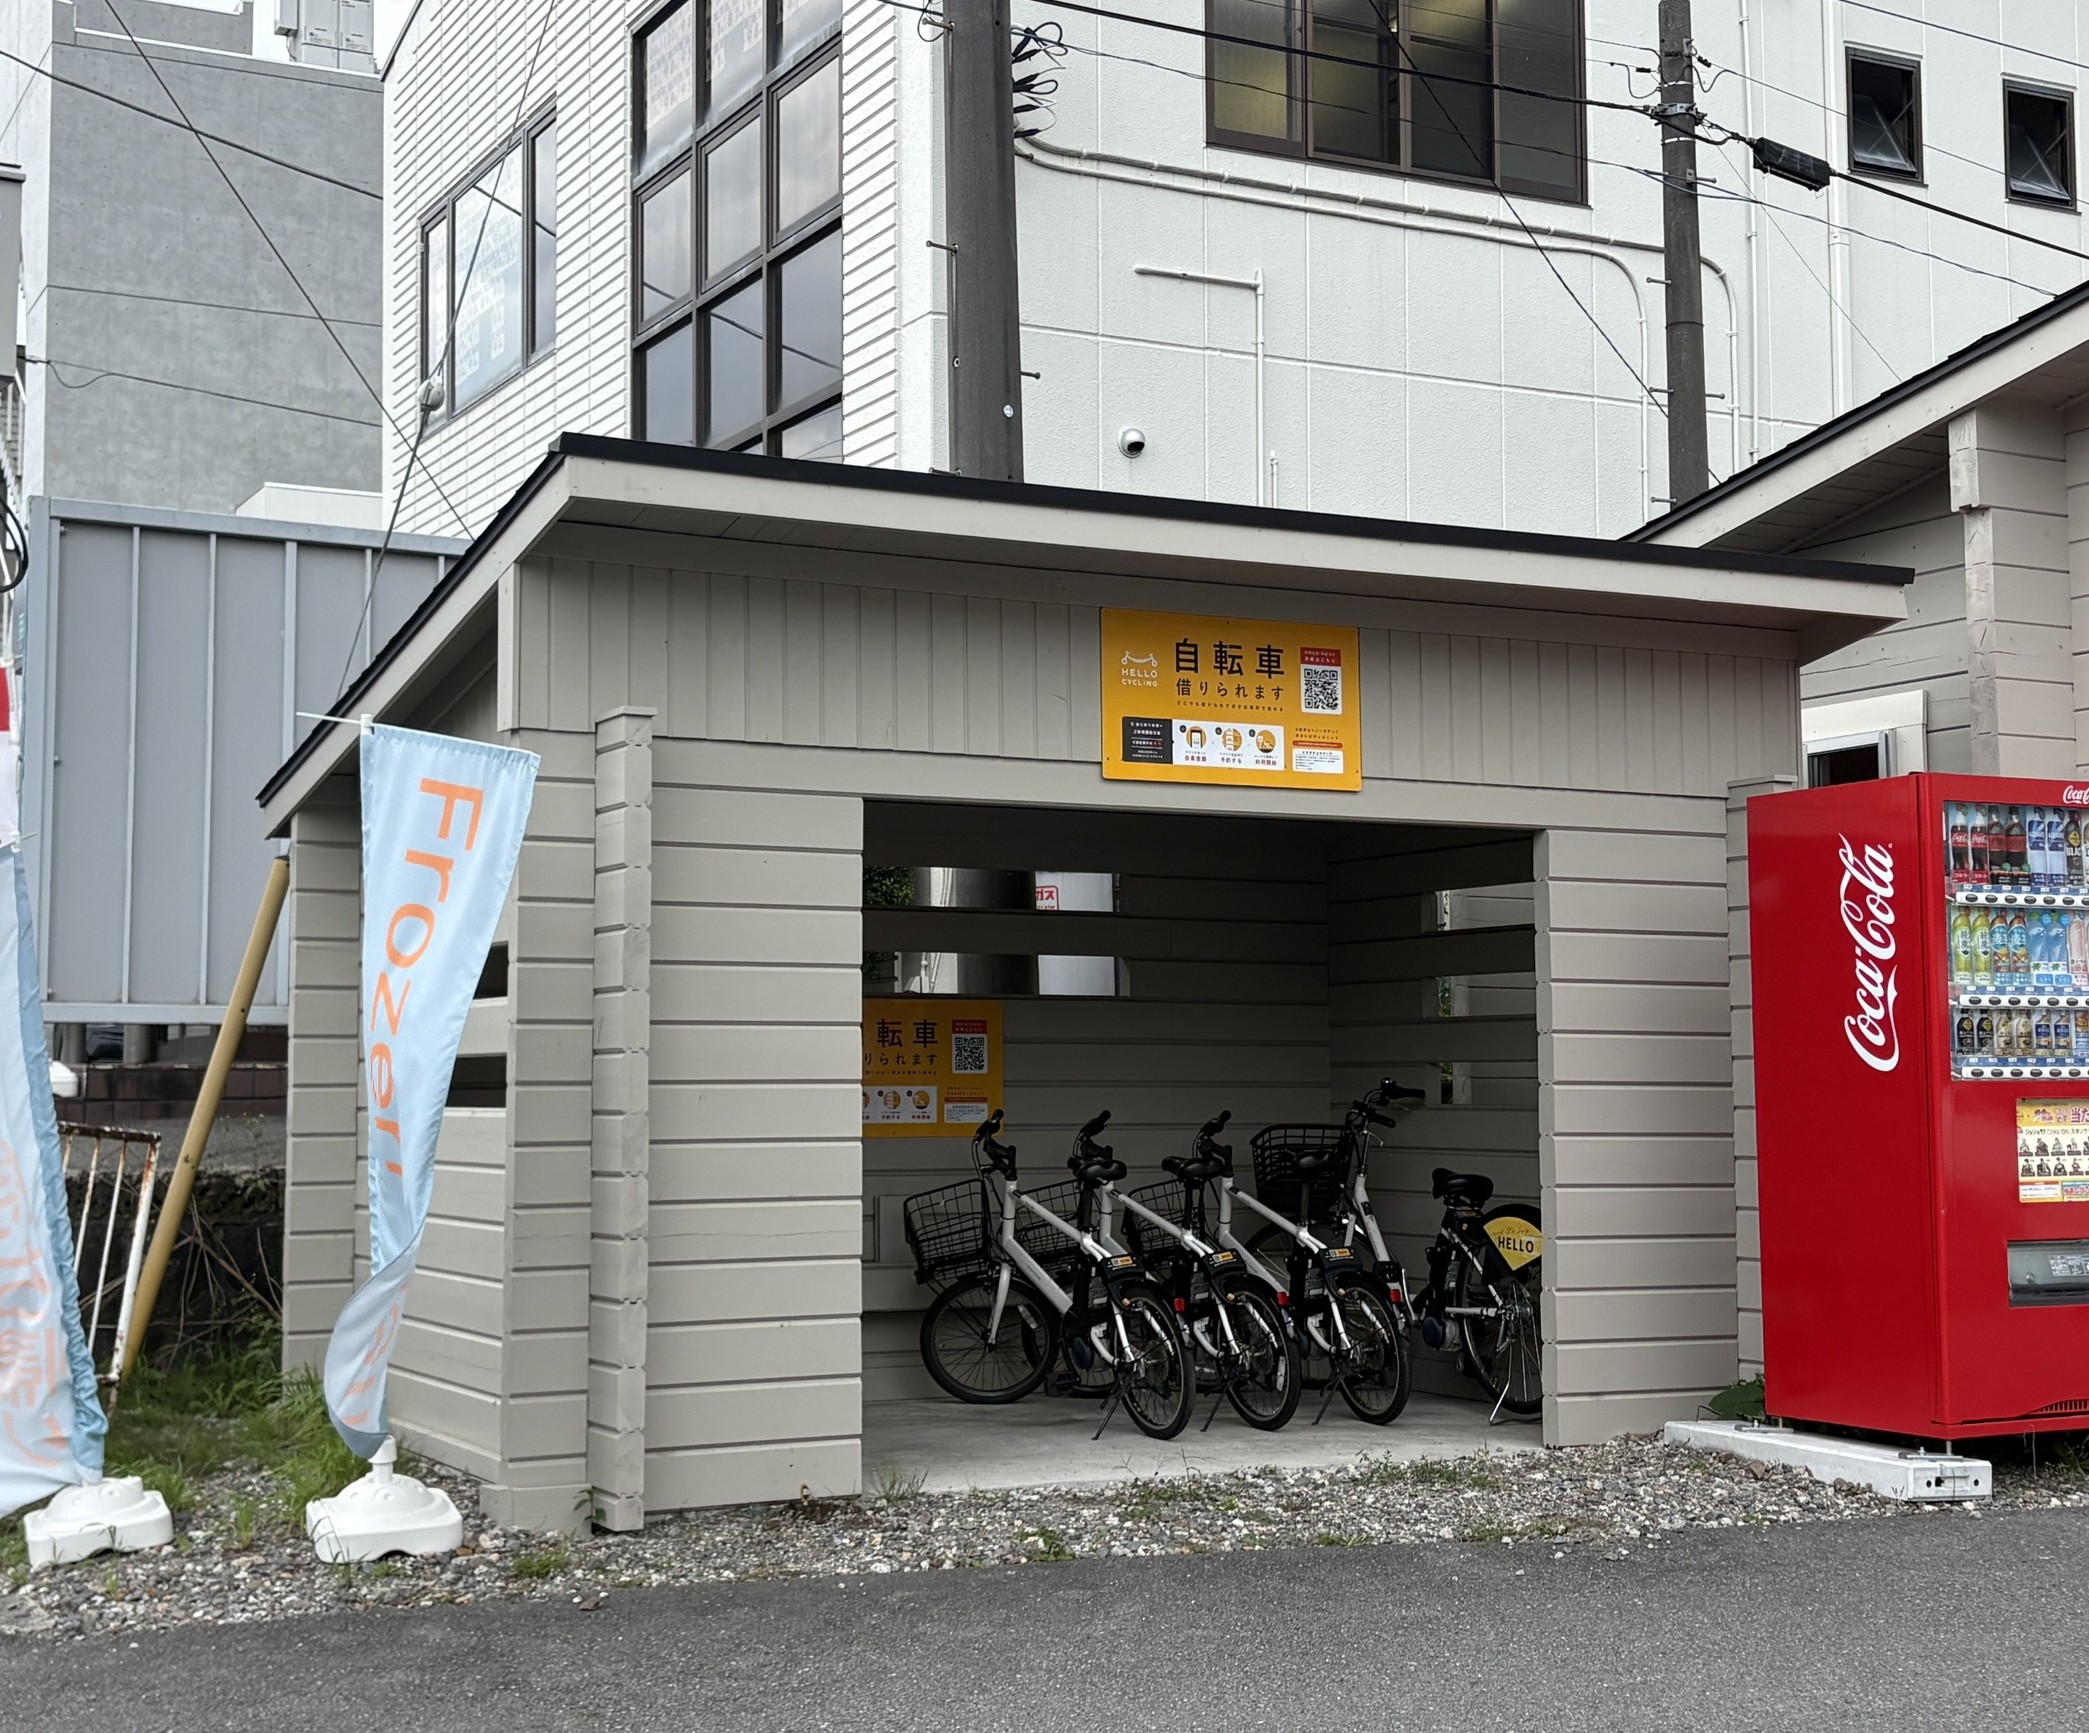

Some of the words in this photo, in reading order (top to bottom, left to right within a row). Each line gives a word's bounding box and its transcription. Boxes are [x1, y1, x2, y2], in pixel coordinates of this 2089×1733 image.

[1174, 637, 1285, 679] 自転車
[1121, 667, 1158, 679] HELLO
[1121, 678, 1158, 688] CYCLING
[1176, 677, 1285, 701] 借りられます
[1838, 832, 1900, 1073] Coca-Cola
[1497, 1235, 1534, 1253] HELLO
